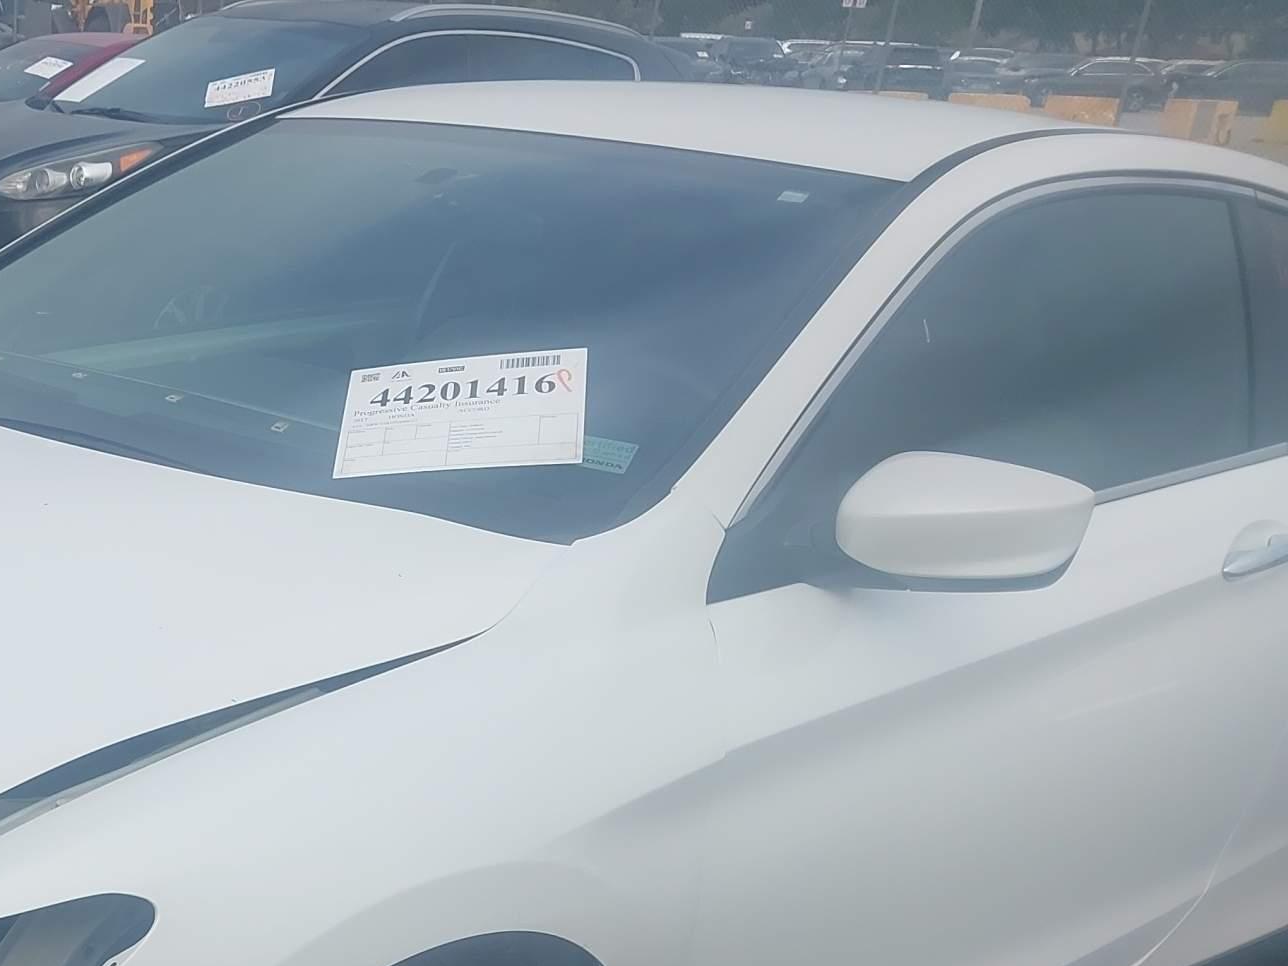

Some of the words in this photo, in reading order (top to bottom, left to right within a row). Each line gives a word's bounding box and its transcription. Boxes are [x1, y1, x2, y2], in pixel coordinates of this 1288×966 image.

[369, 372, 556, 407] 44201416
[410, 401, 451, 411] Casualty
[455, 398, 501, 407] Insurance
